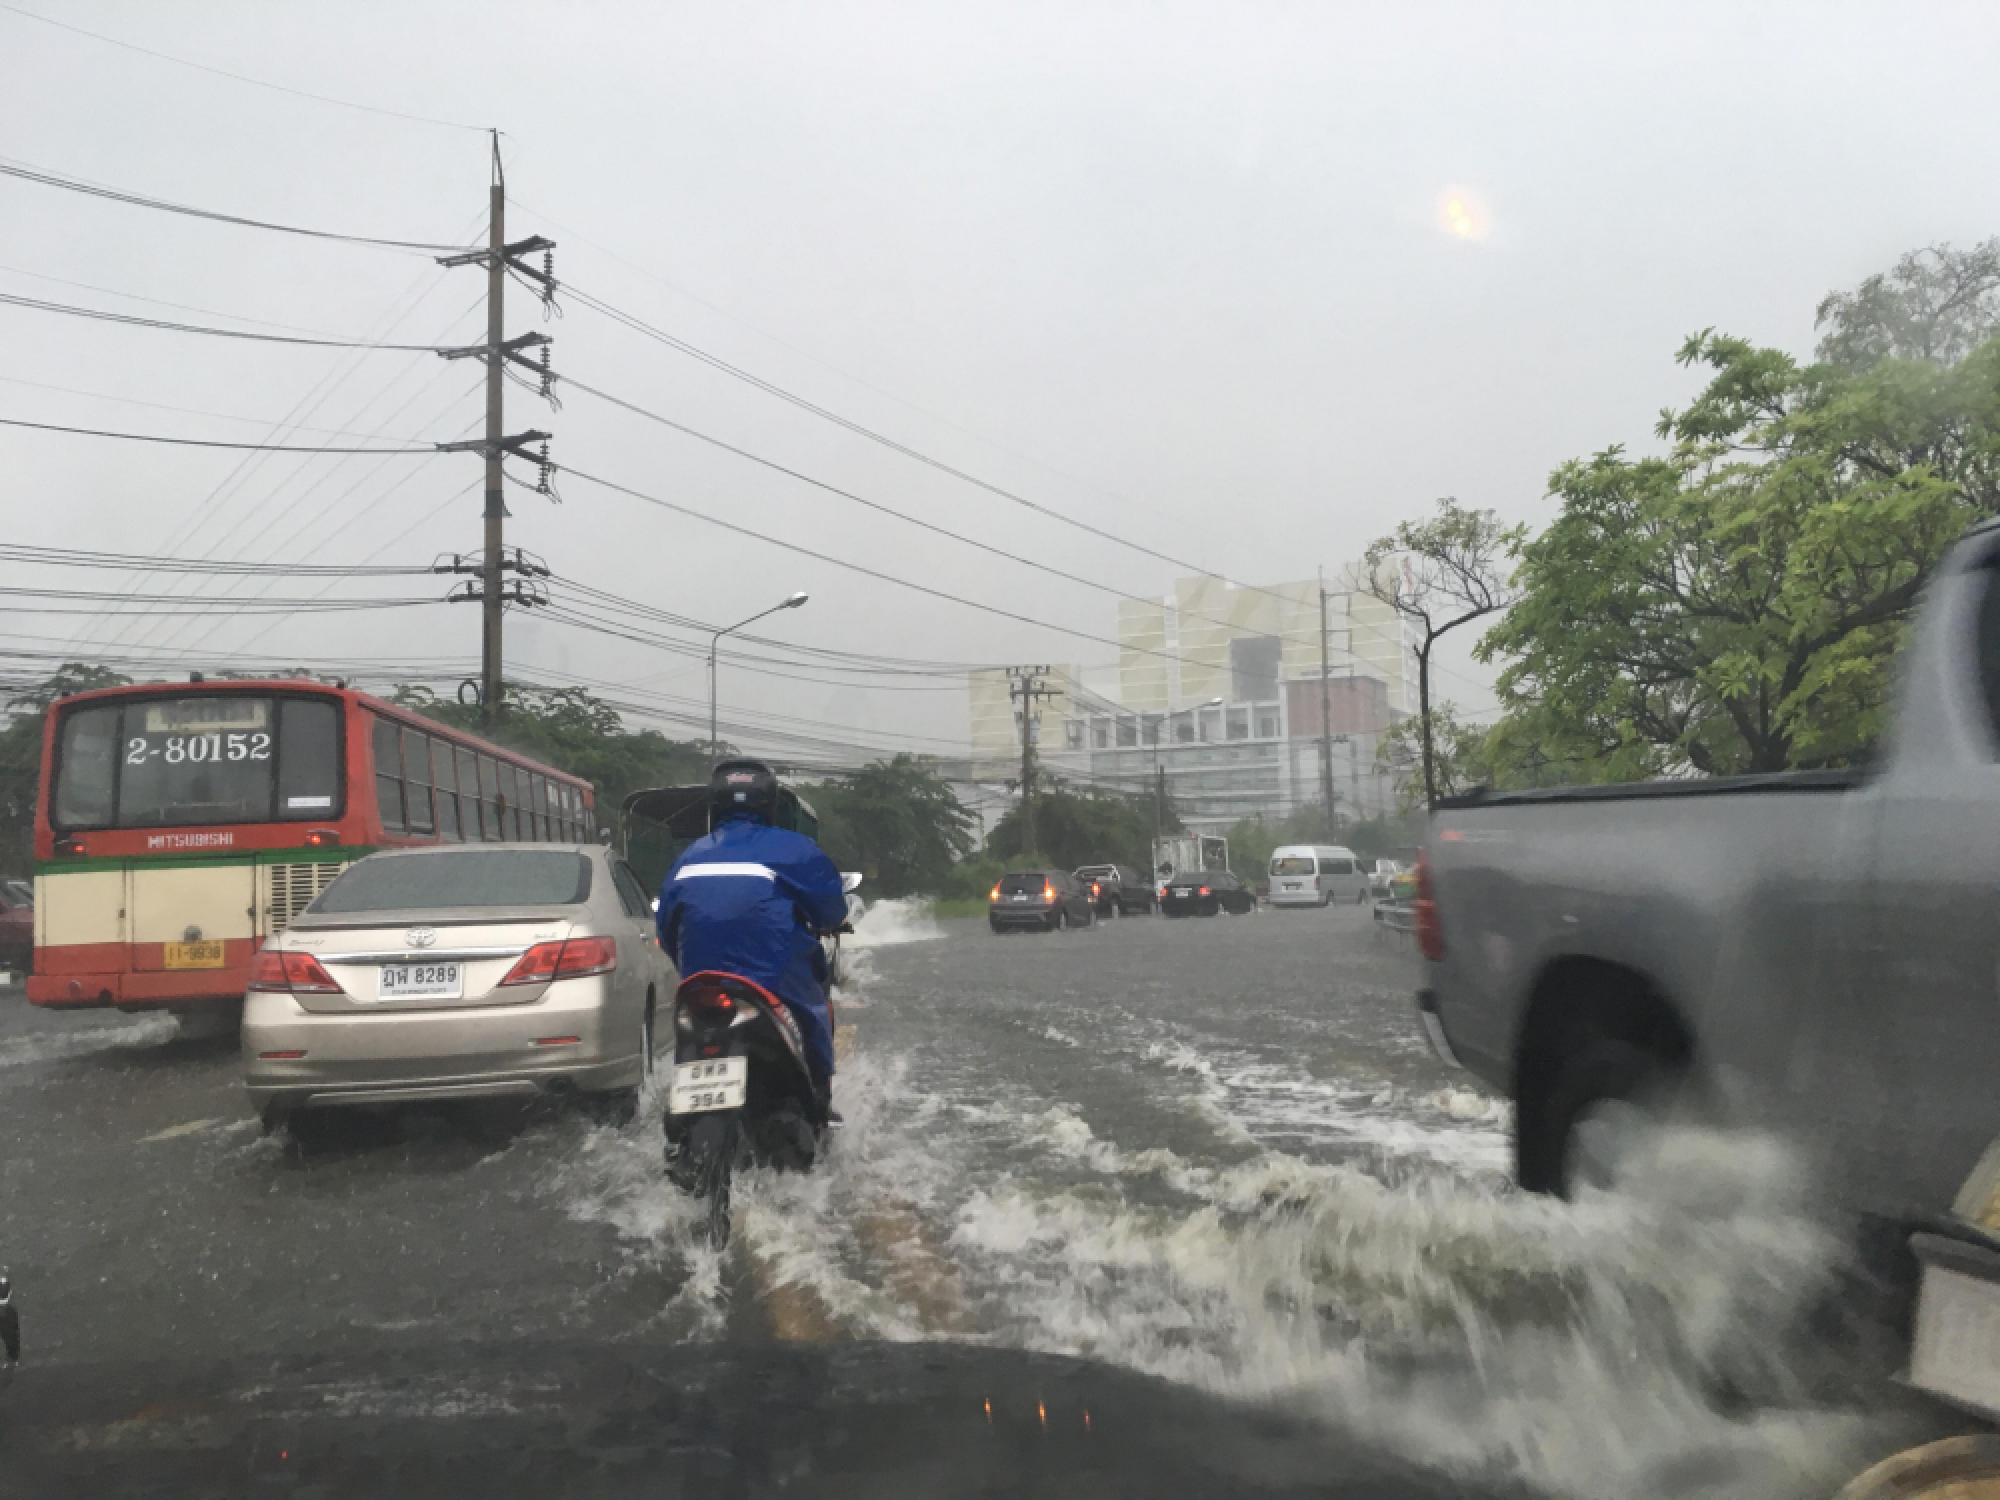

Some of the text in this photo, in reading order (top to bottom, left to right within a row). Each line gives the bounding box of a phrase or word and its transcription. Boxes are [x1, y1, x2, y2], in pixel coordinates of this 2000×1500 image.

[126, 733, 271, 765] 2-80152
[147, 832, 234, 848] MITSUBISHI
[415, 966, 457, 984] 8289
